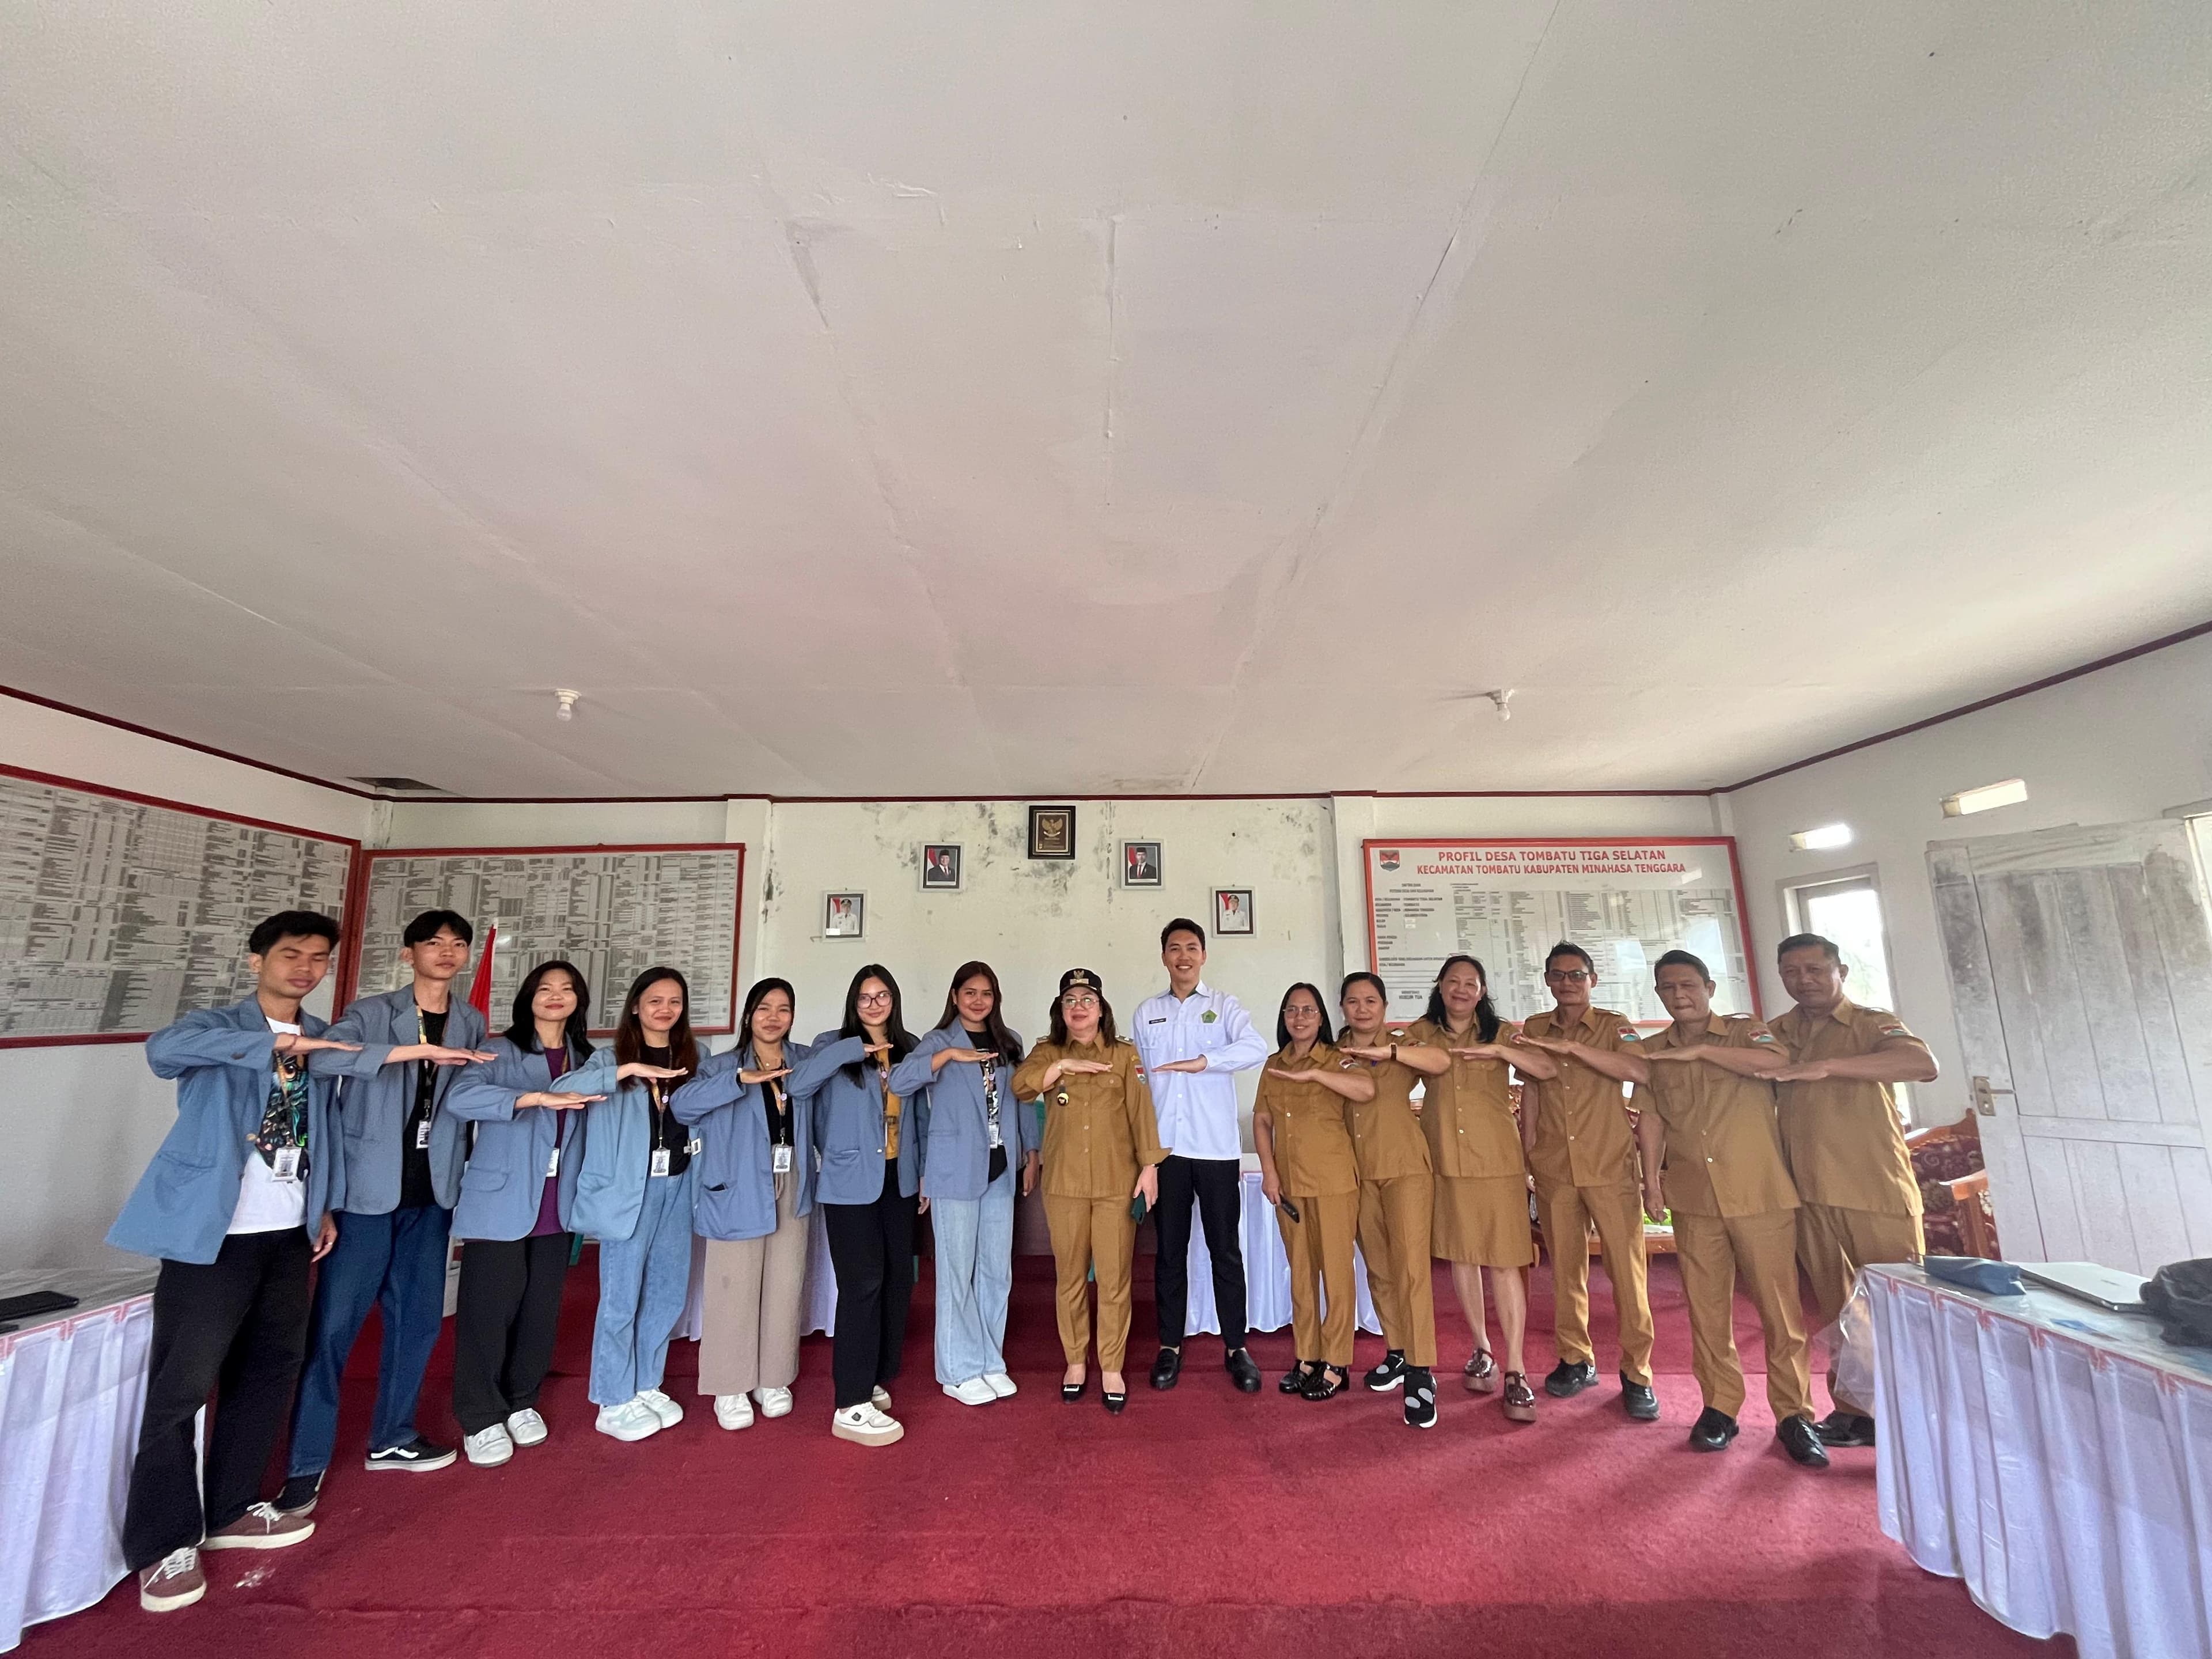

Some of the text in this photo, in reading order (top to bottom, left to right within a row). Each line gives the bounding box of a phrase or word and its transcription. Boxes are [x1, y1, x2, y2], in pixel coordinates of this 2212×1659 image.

[1438, 850, 1666, 861] PROFIL DESA TOMBATU TIGA SELATAN
[1417, 863, 1686, 874] KECAMATAN TOMBATU KABUPATEN MINAHASA TENGGARA
